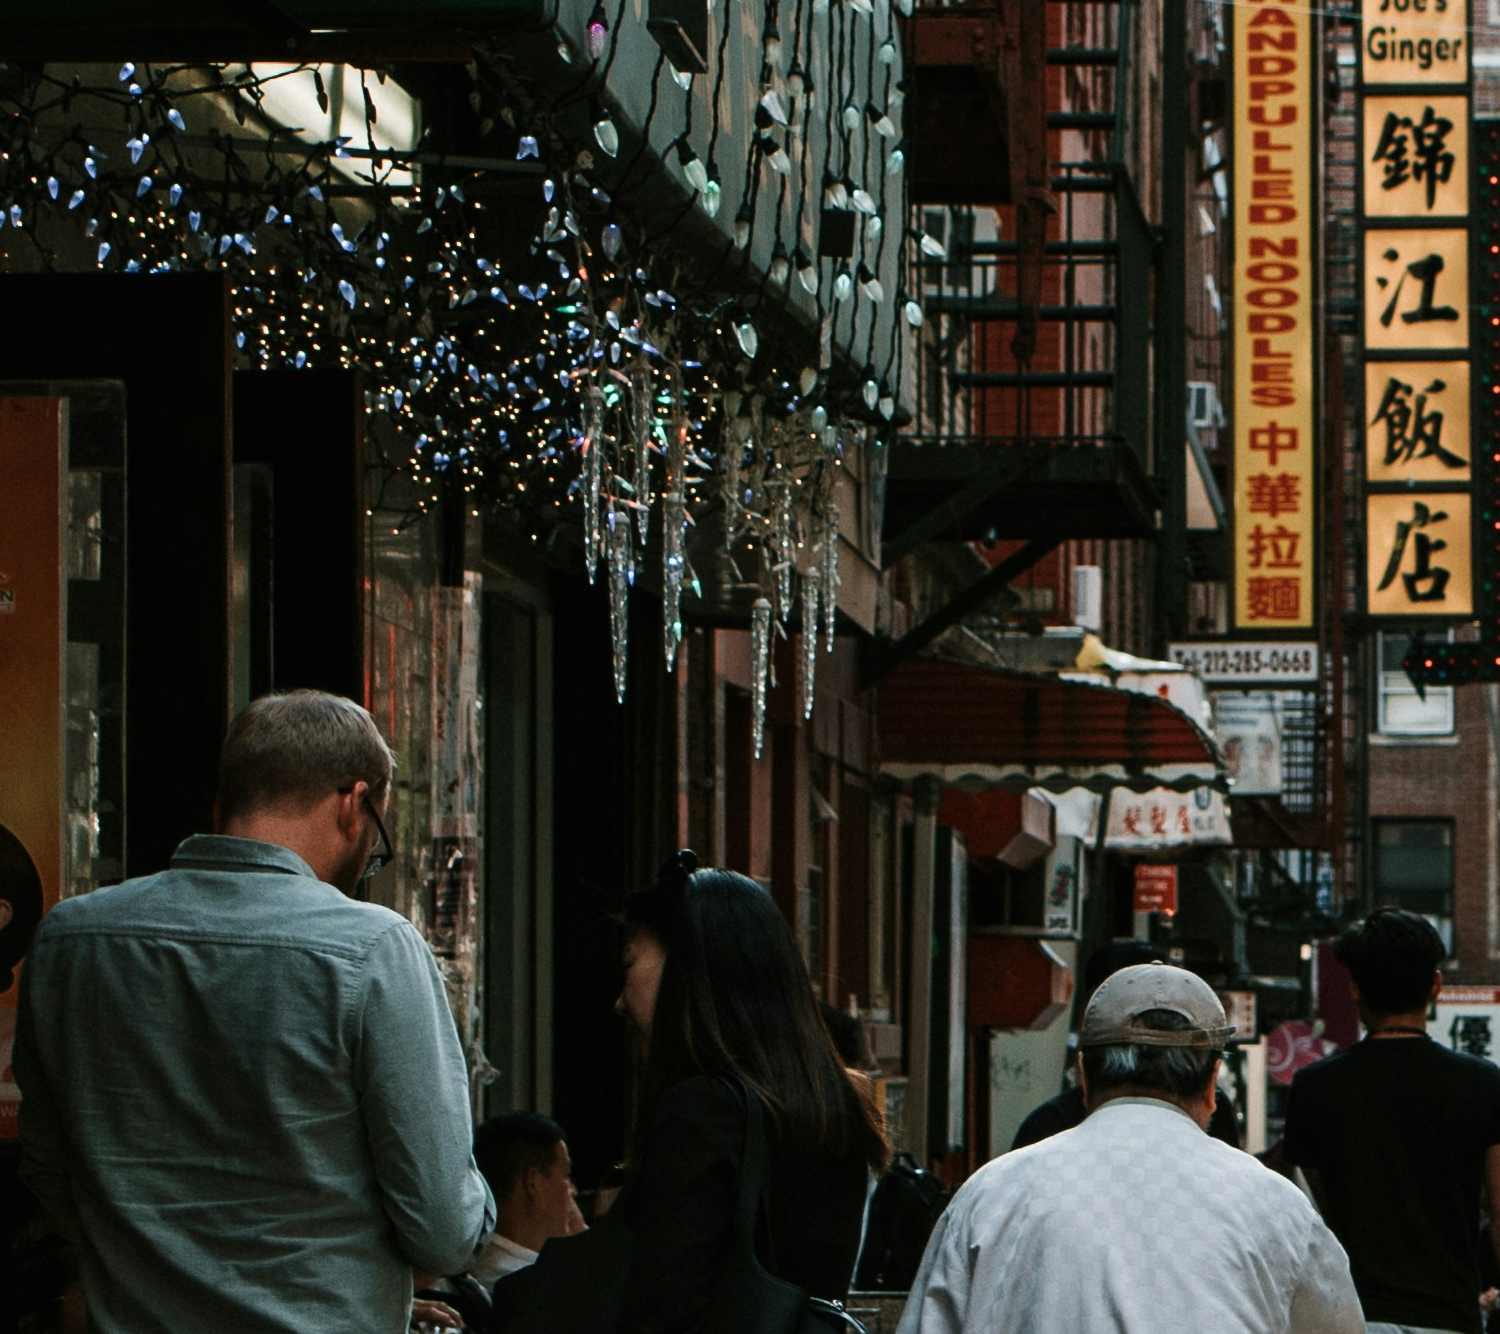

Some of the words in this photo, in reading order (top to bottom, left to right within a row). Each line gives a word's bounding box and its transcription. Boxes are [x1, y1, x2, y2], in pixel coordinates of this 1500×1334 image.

[1367, 26, 1463, 69] Ginger
[1247, 237, 1299, 408] NOODLES
[1372, 106, 1470, 603] 錦江飯店
[1246, 421, 1301, 623] 中華拉麵
